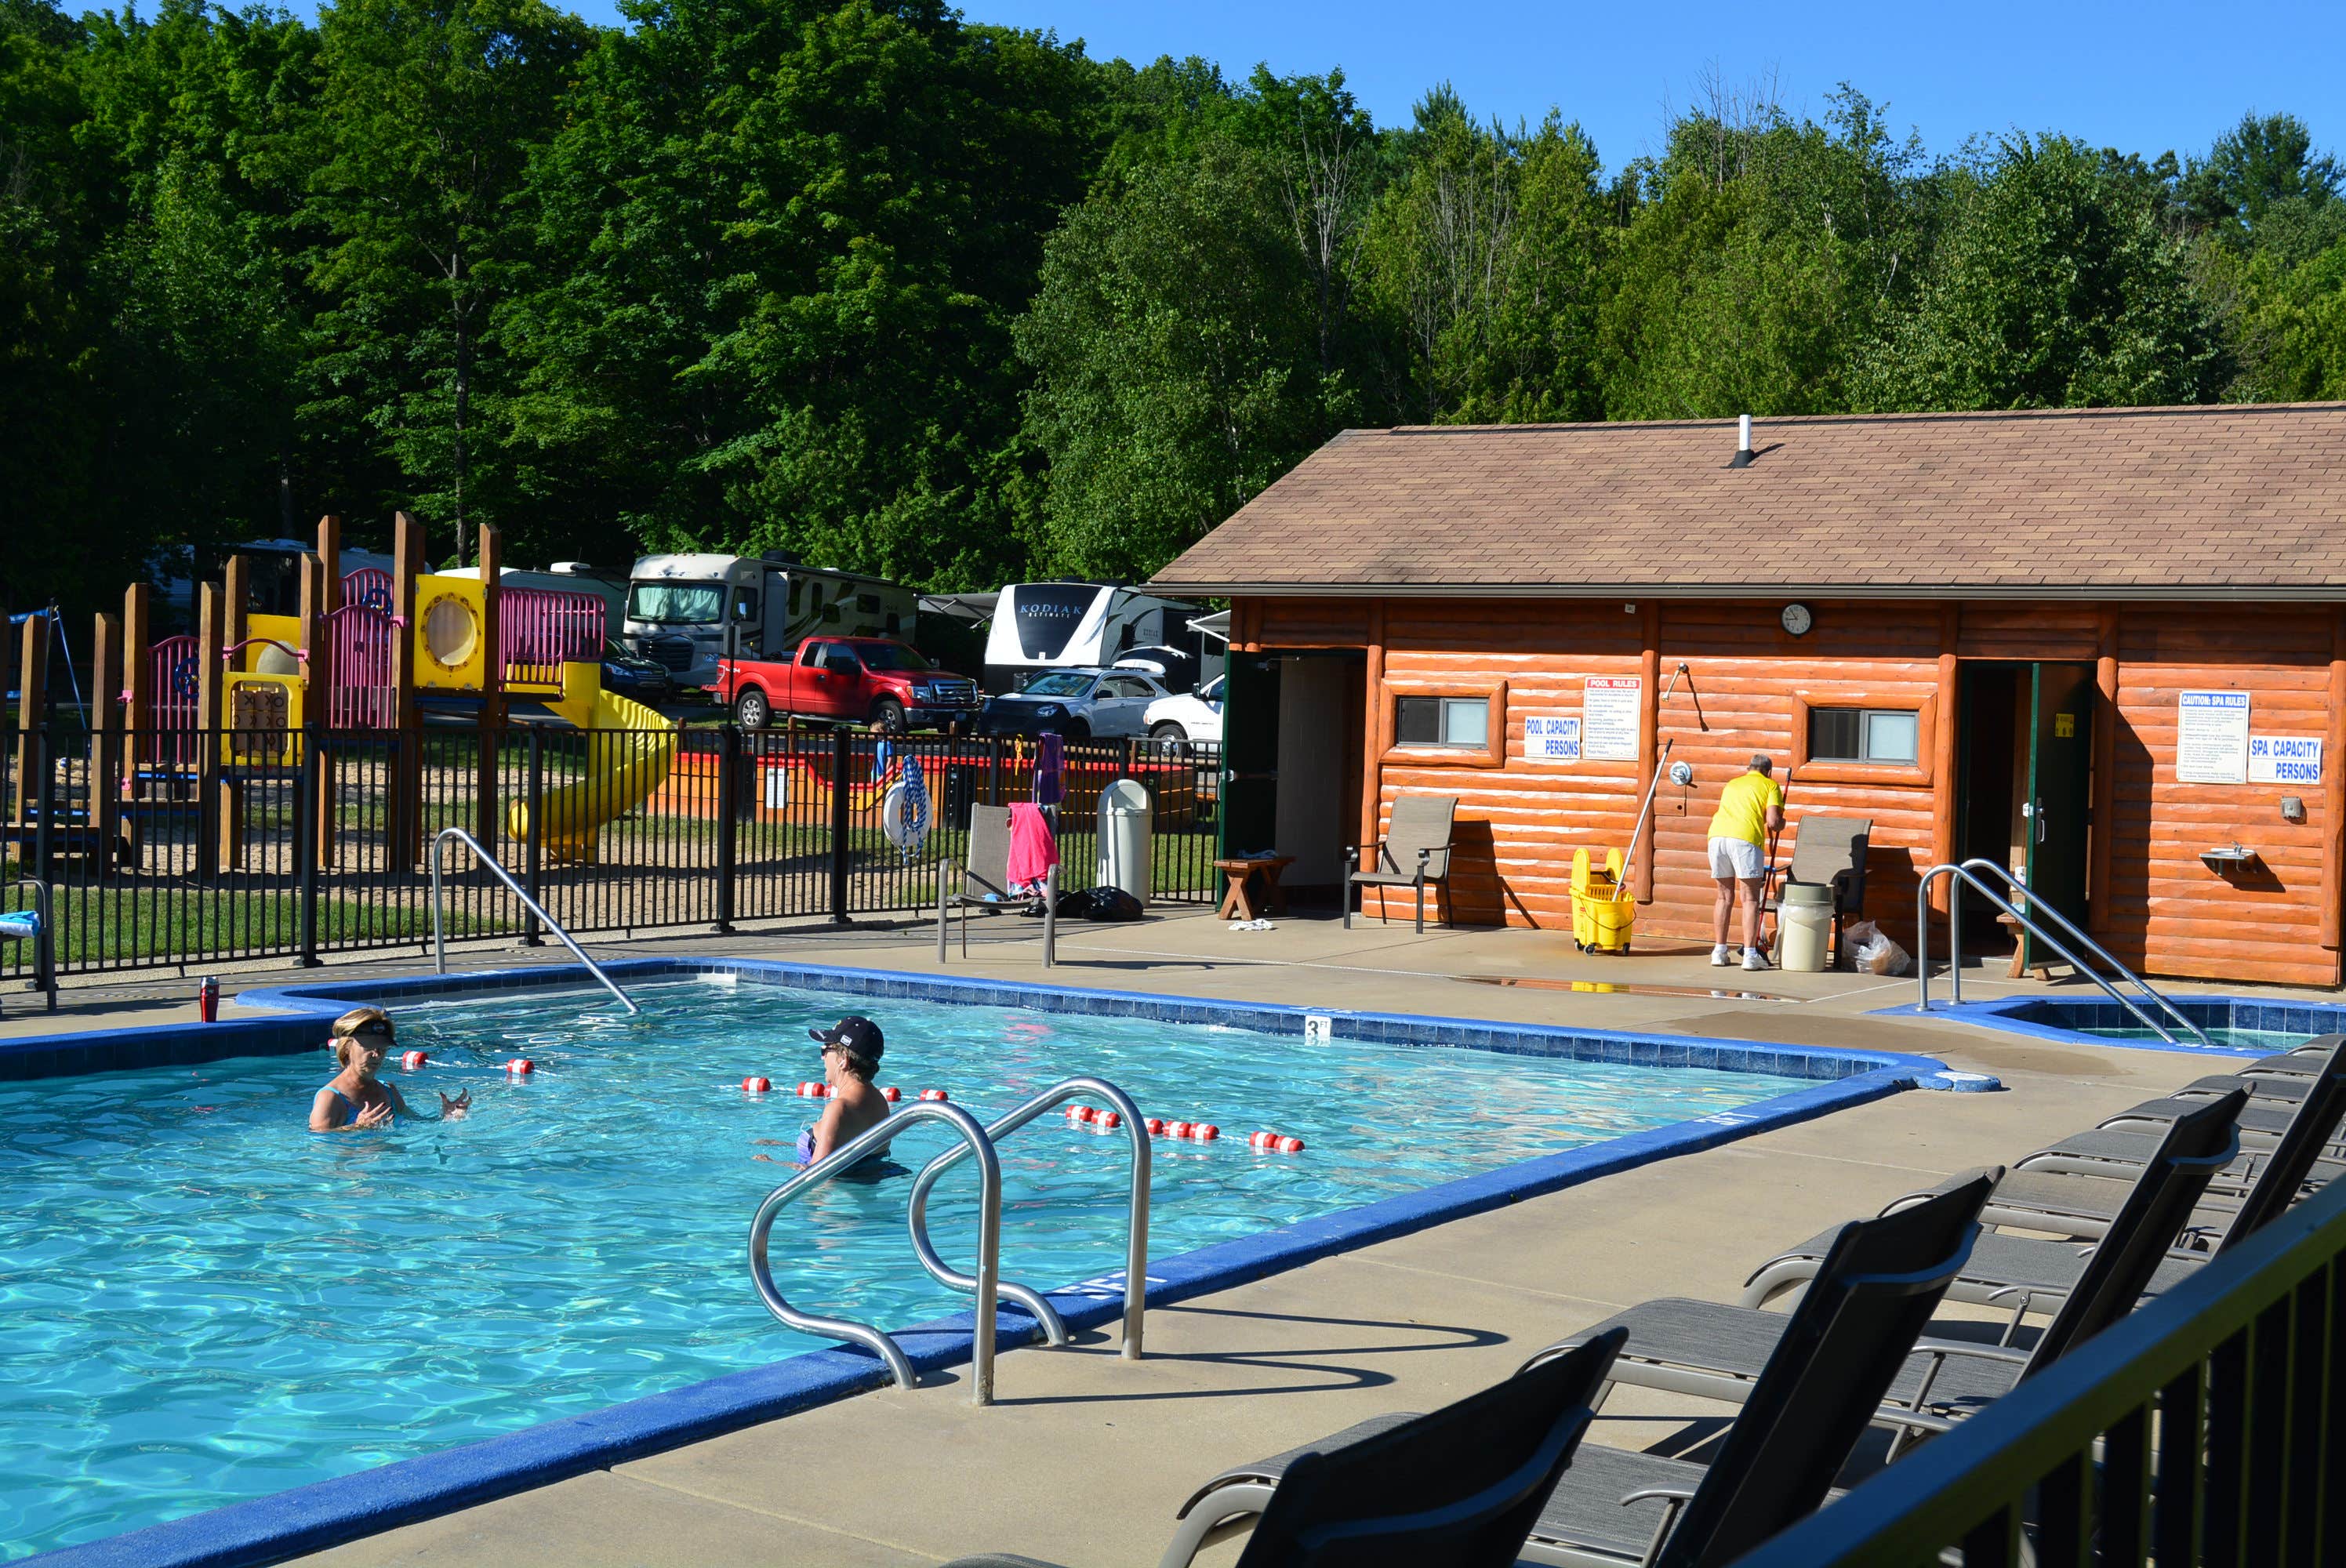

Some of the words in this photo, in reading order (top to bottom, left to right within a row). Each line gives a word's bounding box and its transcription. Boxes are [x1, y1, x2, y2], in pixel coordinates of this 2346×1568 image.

[1020, 604, 1082, 615] KODIAK
[2182, 695, 2211, 706] CAUTION:
[2211, 696, 2224, 706] SPA
[2224, 697, 2246, 707] RULES
[1527, 719, 1543, 735] POOL
[1546, 719, 1578, 735] CAPACITY
[1545, 739, 1578, 756] PERSONS
[2251, 739, 2268, 757] SPA
[2273, 740, 2319, 758] CAPACITY
[2275, 762, 2319, 780] PERSONS
[1308, 1021, 1319, 1036] 3
